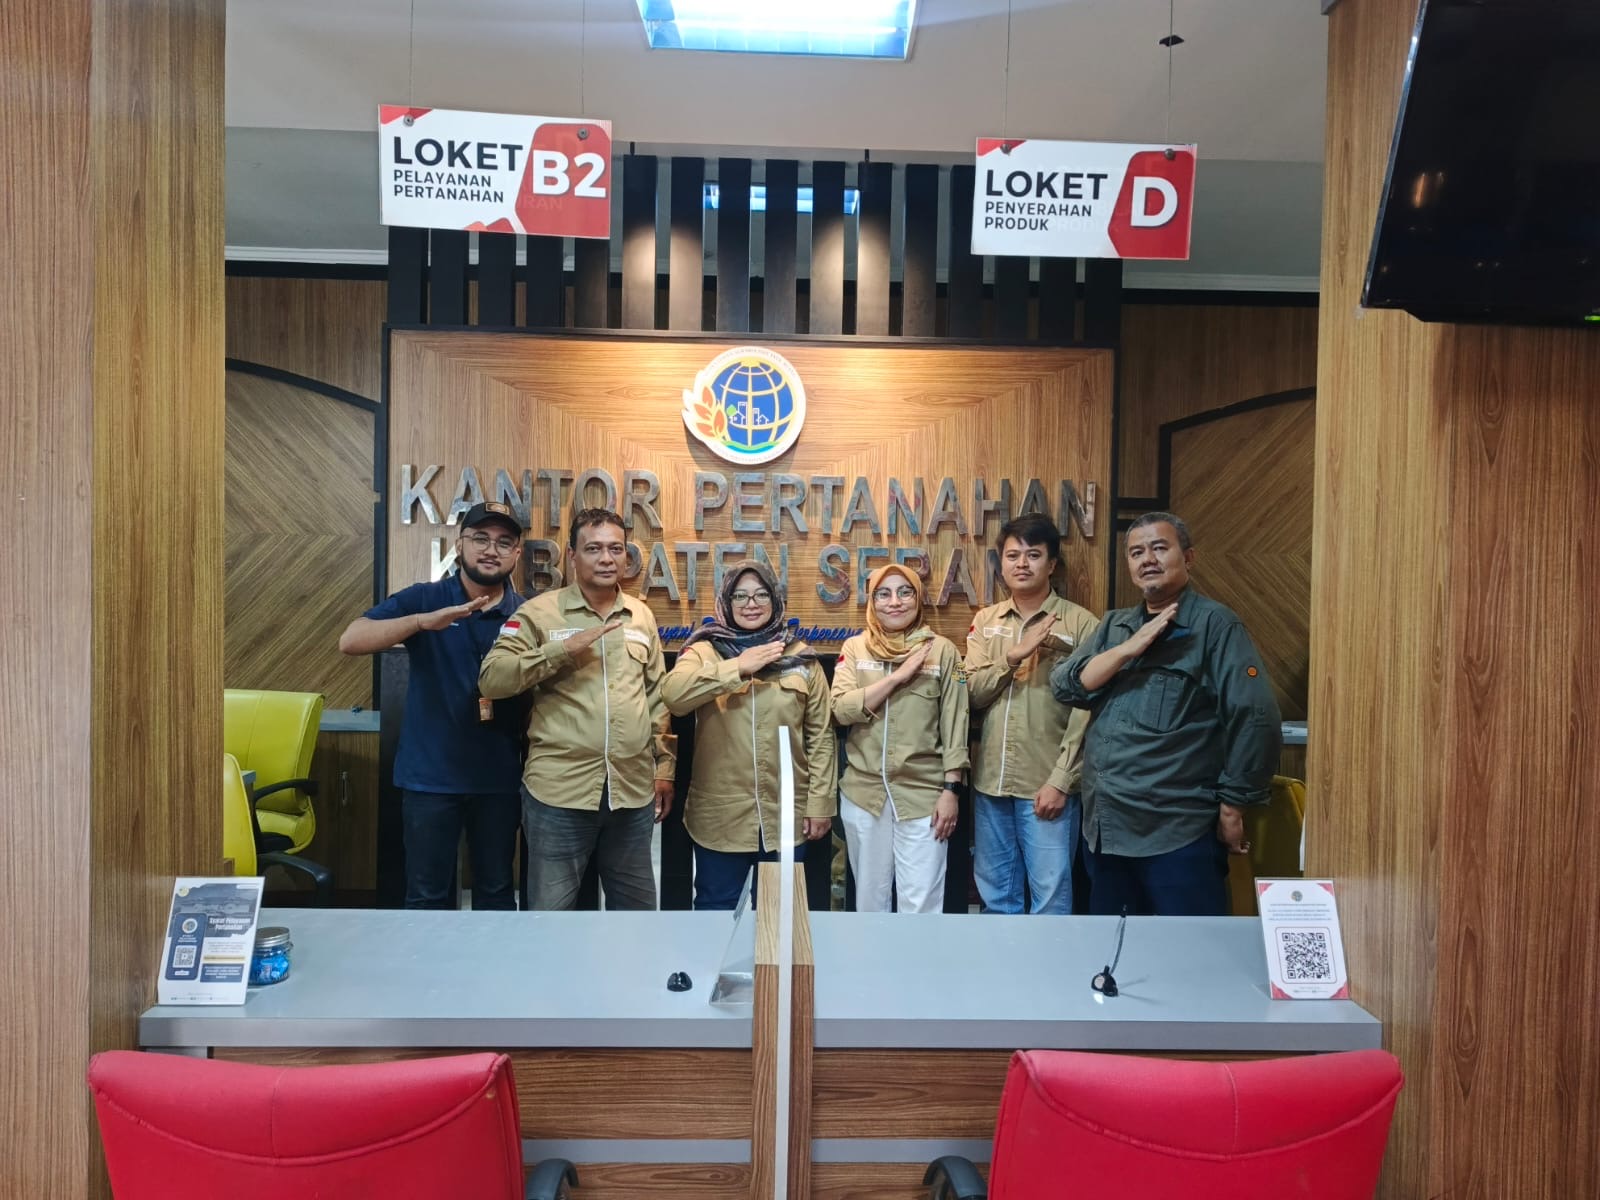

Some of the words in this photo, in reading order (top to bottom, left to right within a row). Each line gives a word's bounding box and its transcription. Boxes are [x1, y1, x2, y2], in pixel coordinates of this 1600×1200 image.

[393, 136, 524, 172] LOKET
[532, 149, 607, 198] B2
[393, 169, 492, 188] PELAYANAN
[393, 184, 504, 204] PERTANAHAN
[985, 169, 1109, 201] LOKET
[1130, 175, 1179, 228] D
[985, 201, 1092, 217] PENYERAHAN
[984, 216, 1050, 232] PRODUK
[401, 464, 663, 529] KANTOR
[694, 470, 1097, 538] PERTANAHAN
